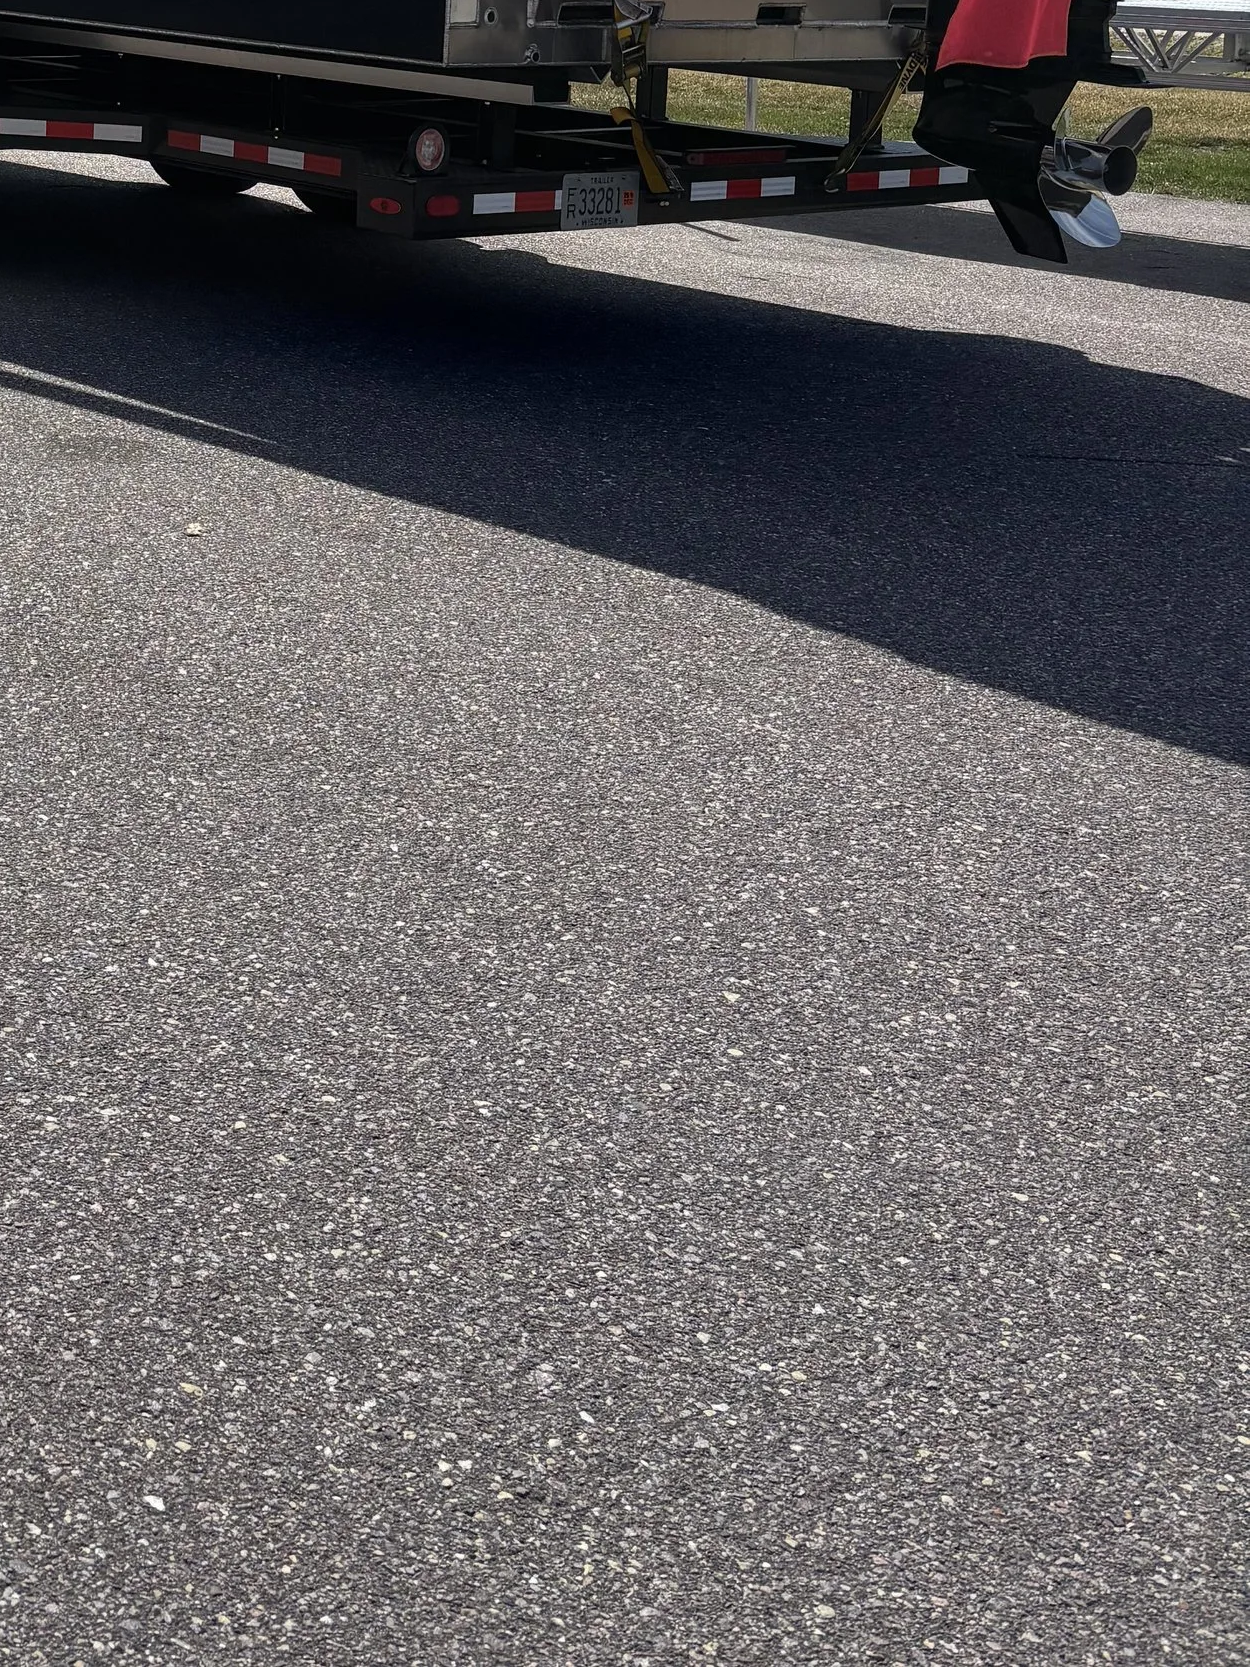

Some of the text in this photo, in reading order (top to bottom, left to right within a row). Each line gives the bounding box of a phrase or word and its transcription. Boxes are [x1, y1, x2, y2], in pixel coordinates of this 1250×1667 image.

[591, 177, 614, 185] TRAILER
[578, 187, 621, 215] 33281
[582, 218, 618, 227] WISCONSIN
